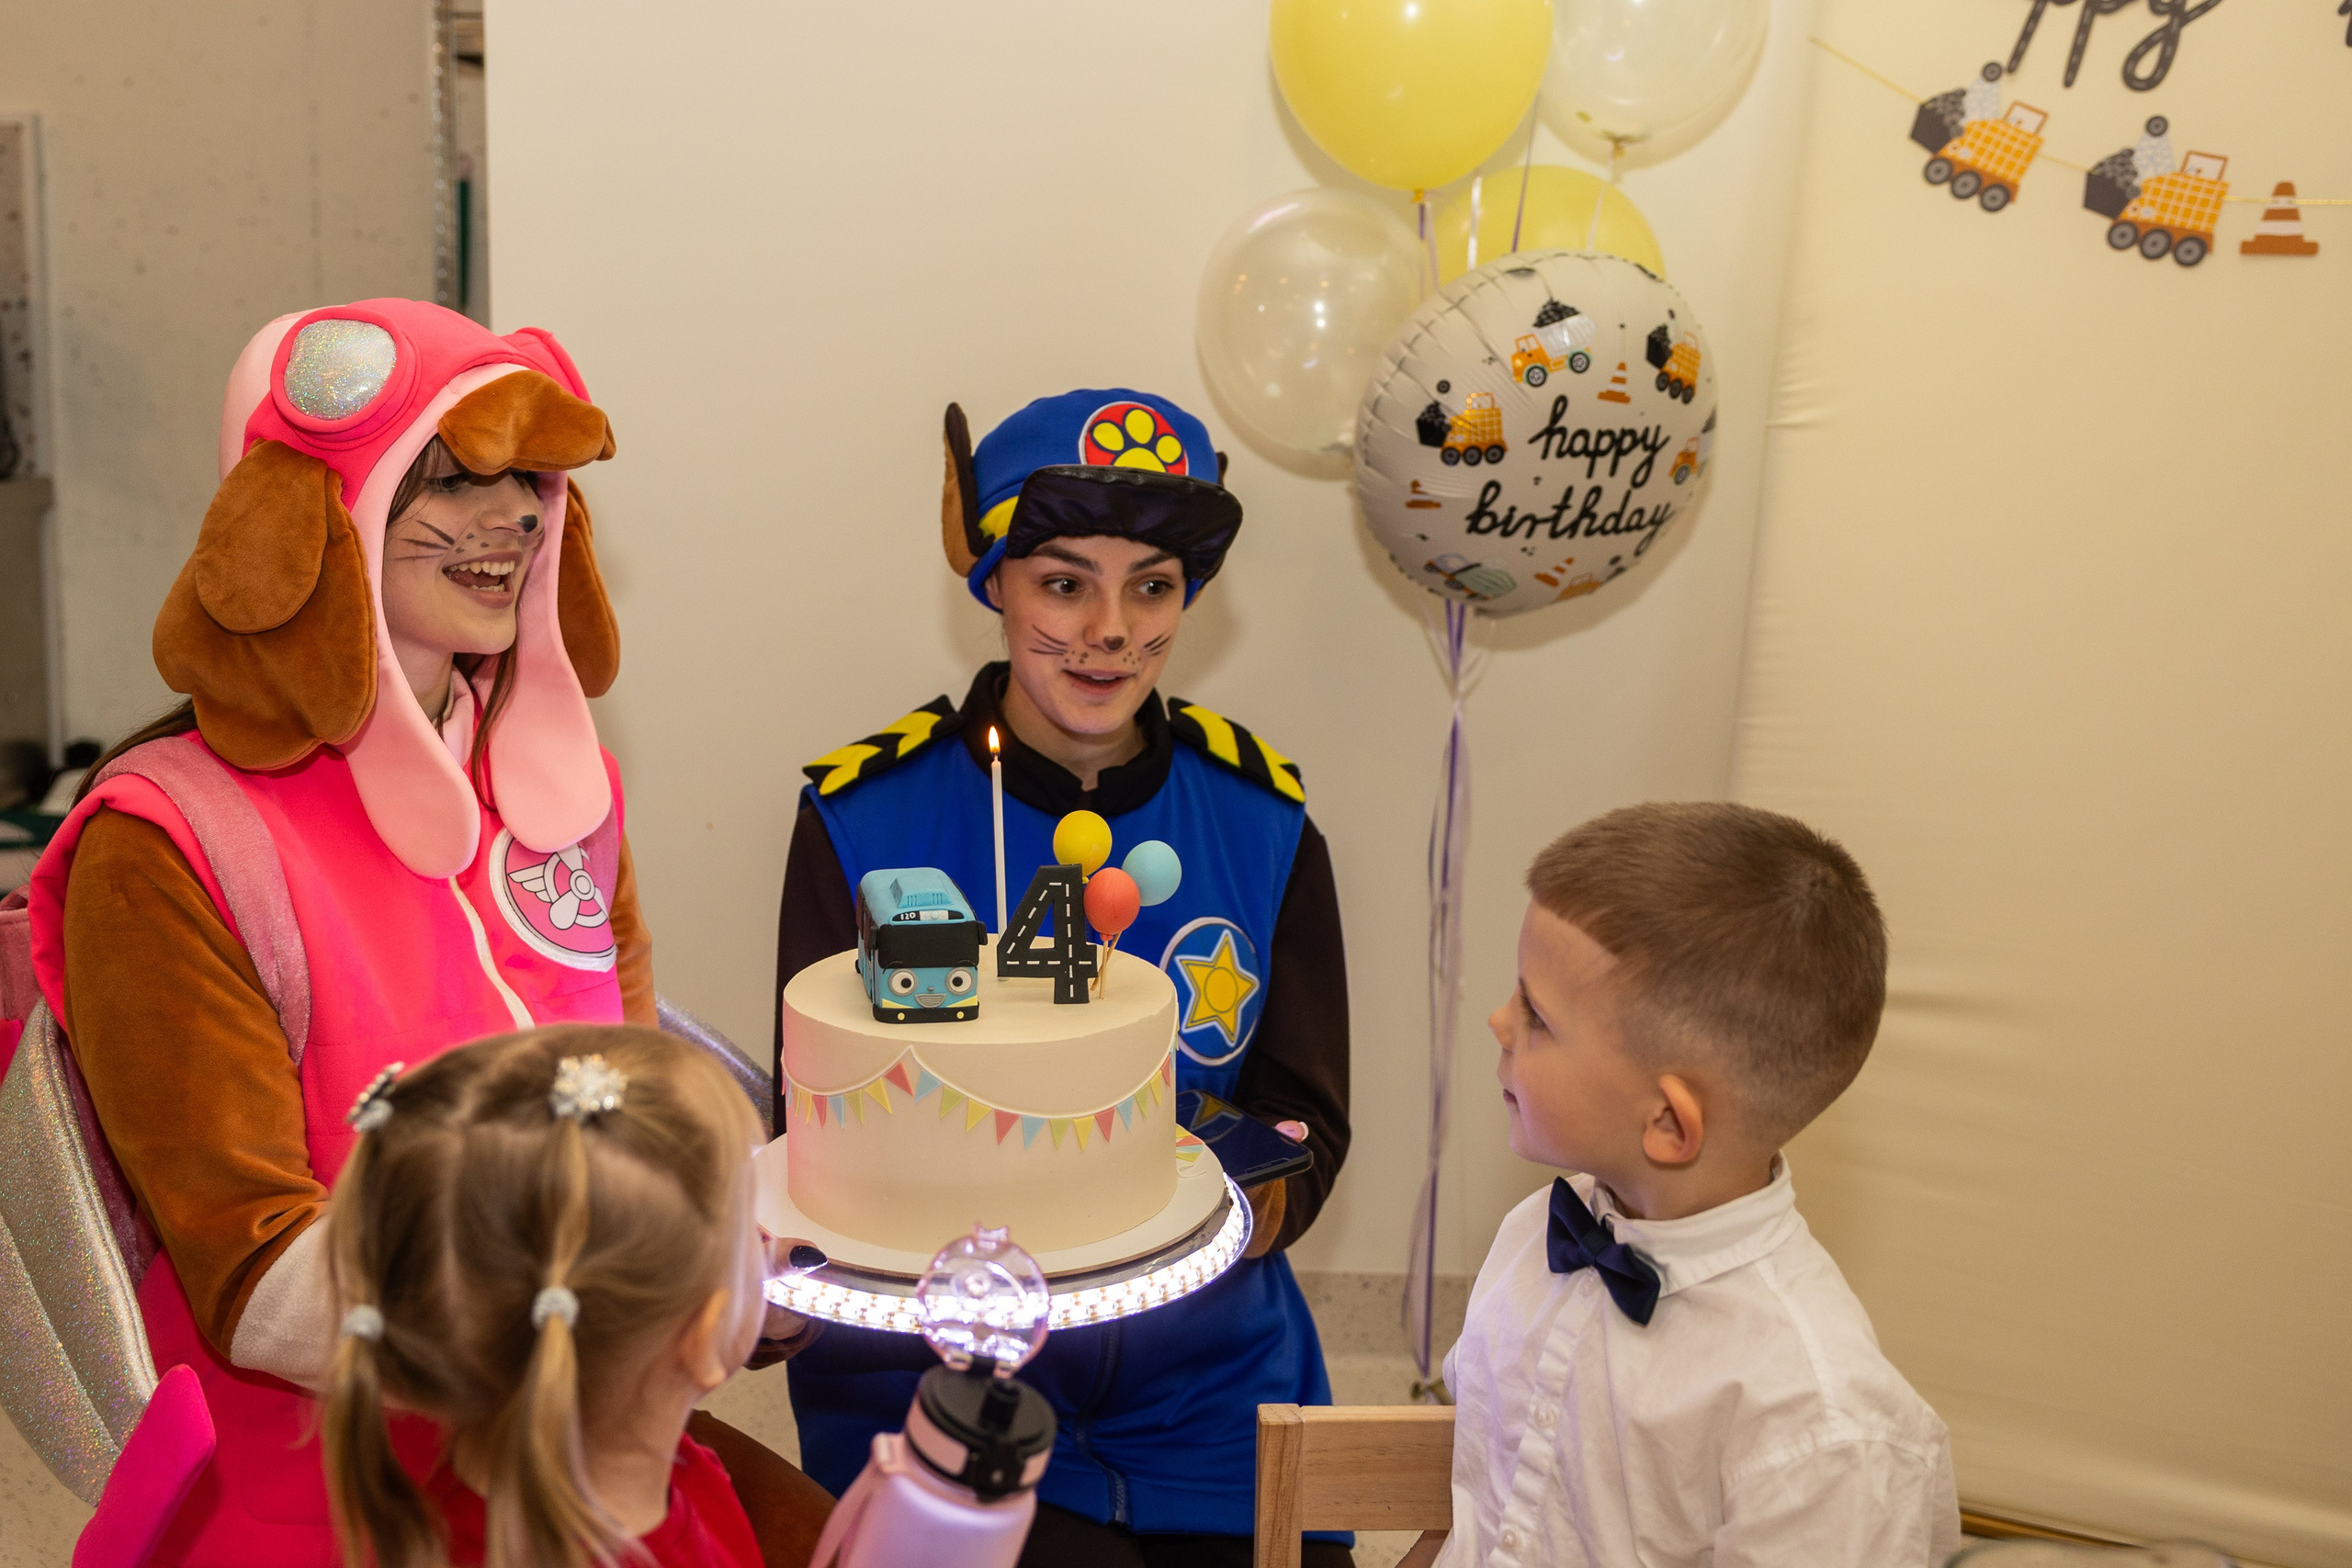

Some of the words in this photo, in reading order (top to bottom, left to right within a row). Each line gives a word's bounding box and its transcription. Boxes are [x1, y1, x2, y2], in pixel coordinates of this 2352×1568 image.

[1528, 394, 1671, 489] happy
[1464, 479, 1677, 558] birthday
[900, 912, 916, 920] 120
[997, 863, 1098, 1004] 4
